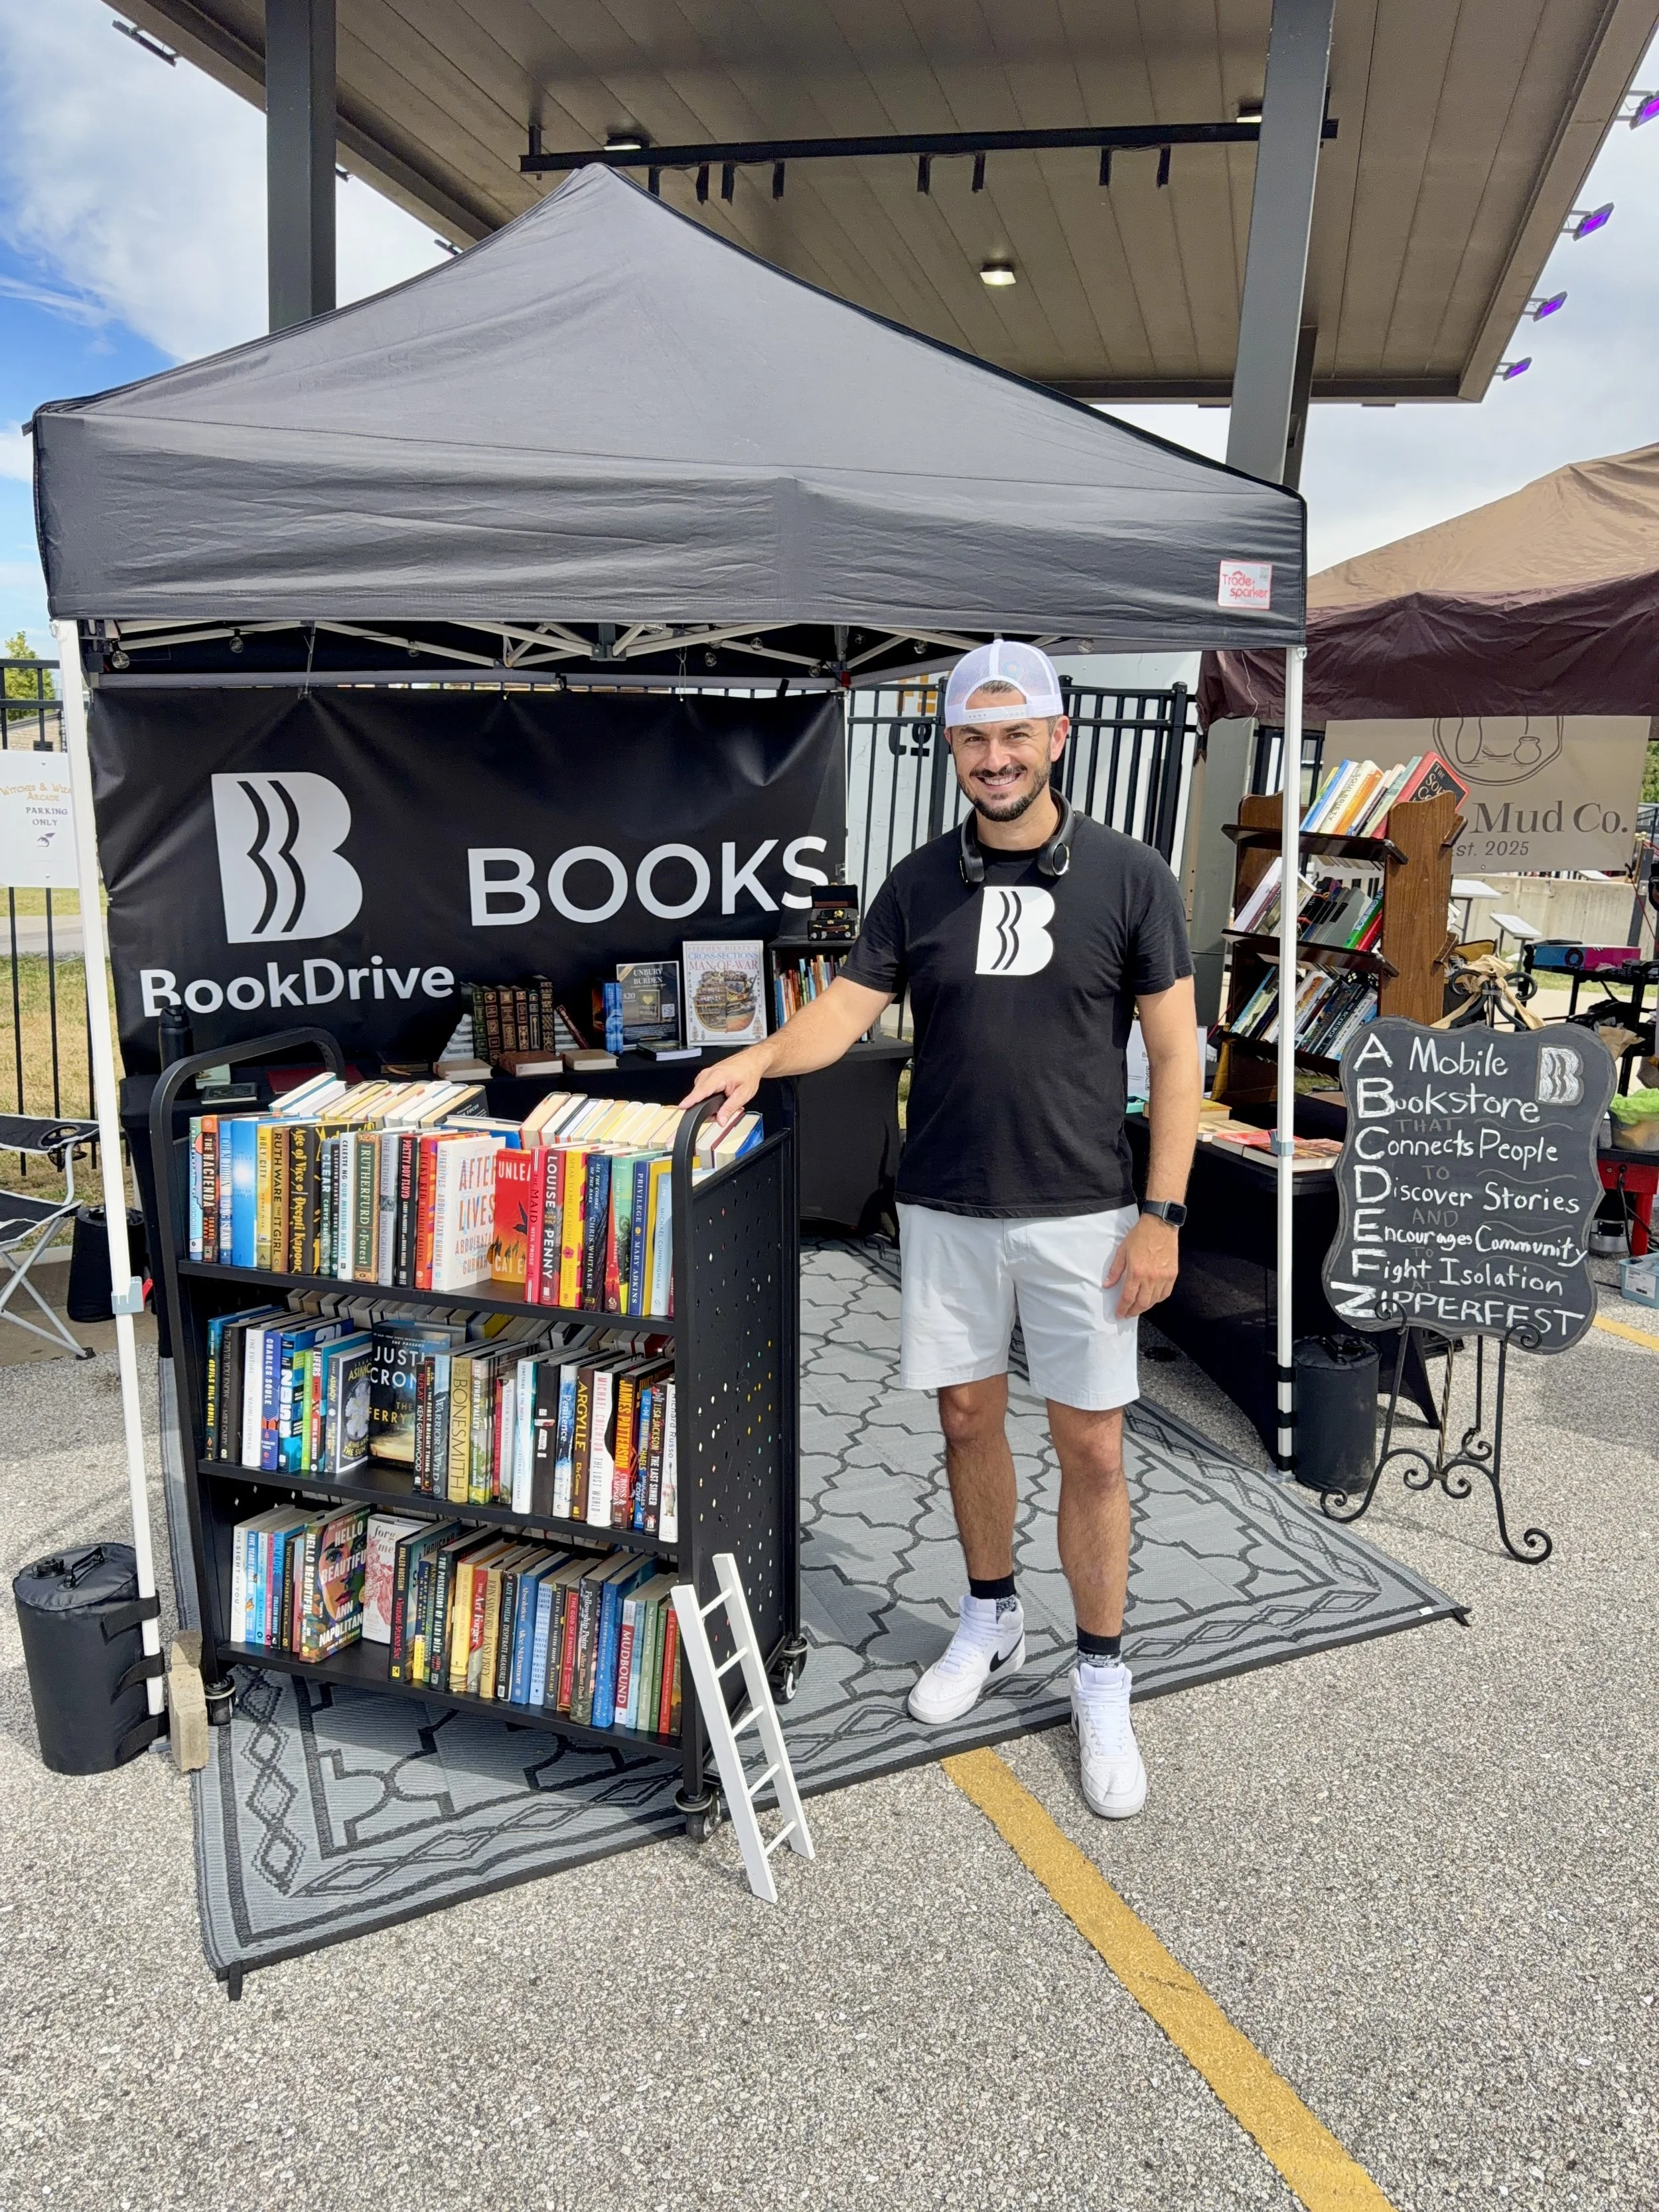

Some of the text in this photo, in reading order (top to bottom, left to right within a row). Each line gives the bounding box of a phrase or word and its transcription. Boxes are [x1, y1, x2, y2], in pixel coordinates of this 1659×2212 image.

[39, 782, 47, 791] &
[25, 806, 68, 815] PARKING
[1469, 800, 1628, 834] Mud Co.
[1453, 841, 1529, 856] st. 2025
[468, 836, 829, 926] BOOKS
[633, 968, 663, 977] UNBURY
[633, 977, 663, 986] BURDEN
[689, 960, 758, 971] MAN-OF-WAR
[140, 956, 455, 1017] BookDrive
[1328, 1010, 1349, 1040] SCOURGE
[1353, 1033, 1508, 1076] A Mobile
[1357, 1076, 1540, 1124] Bookstore
[291, 1128, 307, 1147] Age
[1396, 1118, 1464, 1132] THAT
[1354, 1126, 1558, 1171] Connects People
[203, 1153, 214, 1207] HACIENDA
[273, 1169, 282, 1203] WARE
[291, 1162, 307, 1182] Vice
[322, 1154, 331, 1193] CLEAR
[342, 1169, 348, 1179] NG
[360, 1149, 372, 1224] RUTHERFURD
[401, 1140, 411, 1199] PRETTY BOY FLOYD
[545, 1155, 558, 1208] LOUISE
[1421, 1165, 1450, 1180] TO
[530, 1189, 539, 1224] MAID
[1354, 1165, 1580, 1214] Discover Stories
[221, 1197, 231, 1247] LONG ISLAND
[274, 1217, 281, 1228] IT
[290, 1197, 307, 1274] Deepti Kapoor
[1412, 1209, 1459, 1228] AND
[359, 1234, 369, 1264] Forest
[542, 1230, 555, 1280] PENNY
[1222, 1236, 1252, 1250] Trade
[1353, 1209, 1589, 1268] Encourages Community
[463, 1255, 488, 1275] GURNAH
[1230, 1250, 1267, 1264] sparker
[1351, 1248, 1563, 1296] Fight Isolation
[1331, 1281, 1586, 1336] ZIPPERFEST
[433, 1394, 446, 1447] WARRIOR
[560, 1395, 571, 1442] Penitence
[575, 1380, 588, 1452] ARGYLLE
[614, 1380, 633, 1469] JAMES PATTERSON
[450, 1378, 468, 1489] BONESMITH
[652, 1420, 660, 1451] JACKSON
[433, 1451, 445, 1481] WILD
[649, 1468, 659, 1484] LAST
[650, 1455, 660, 1467] THE
[591, 1458, 603, 1512] THE LOST WORLD
[648, 1484, 658, 1506] SINNER
[334, 1520, 364, 1547] HELLO
[303, 1534, 316, 1615] HELLO BEAUTIFUL
[436, 1571, 445, 1609] POSSESSION
[335, 1600, 354, 1621] ANN
[435, 1611, 443, 1619] OF
[474, 1594, 484, 1611] Art
[521, 1585, 530, 1622] Absolution
[470, 1613, 484, 1646] Forger
[481, 1580, 496, 1678] JOHN SANDFORD EASY PREY
[581, 1590, 593, 1650] Fellowship Point
[501, 1624, 510, 1653] DESPERATE
[516, 1646, 525, 1684] McDermott
[617, 1629, 632, 1704] MUDBOUND
